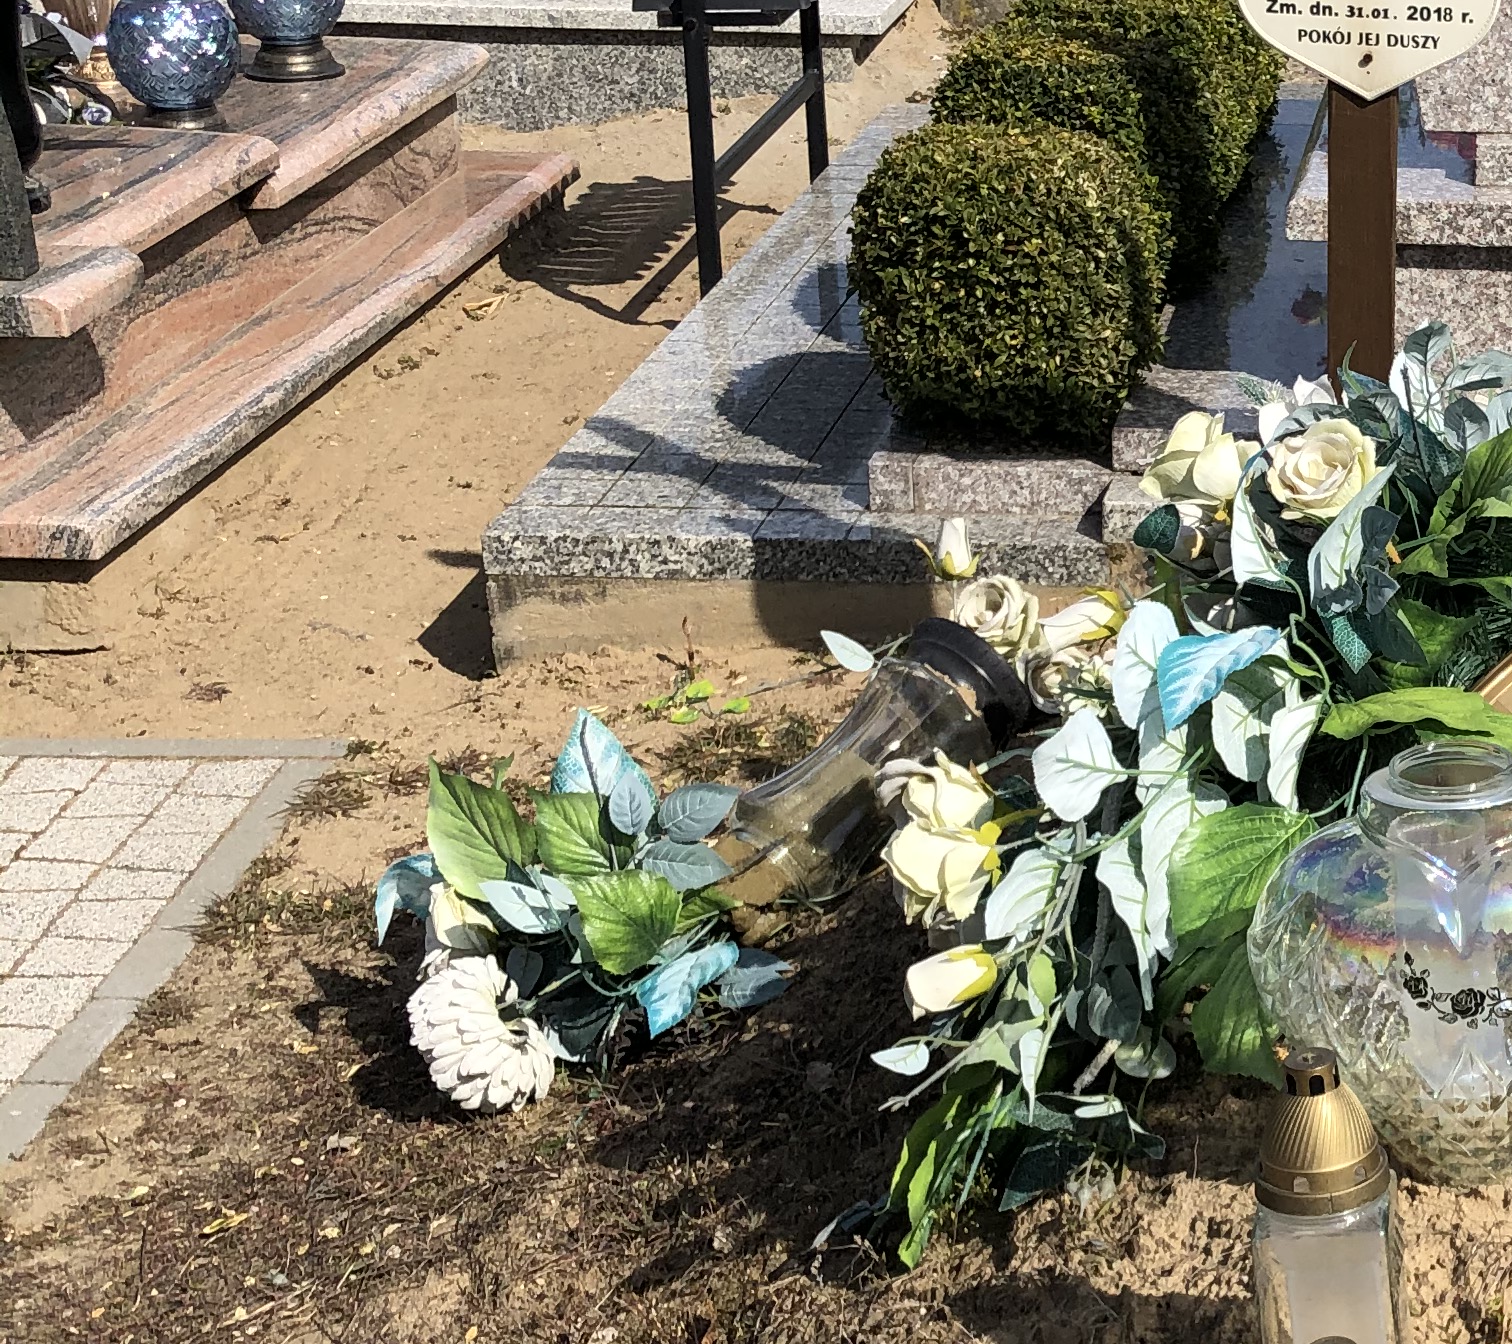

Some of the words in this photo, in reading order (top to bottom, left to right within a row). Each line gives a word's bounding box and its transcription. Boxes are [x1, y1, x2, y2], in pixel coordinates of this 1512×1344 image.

[1309, 1, 1339, 17] dn.
[1406, 6, 1453, 22] 2018
[1461, 11, 1474, 24] r.
[1298, 26, 1352, 45] POKÓJ
[1357, 32, 1380, 47] JEJ
[1387, 34, 1440, 50] DUSZY
